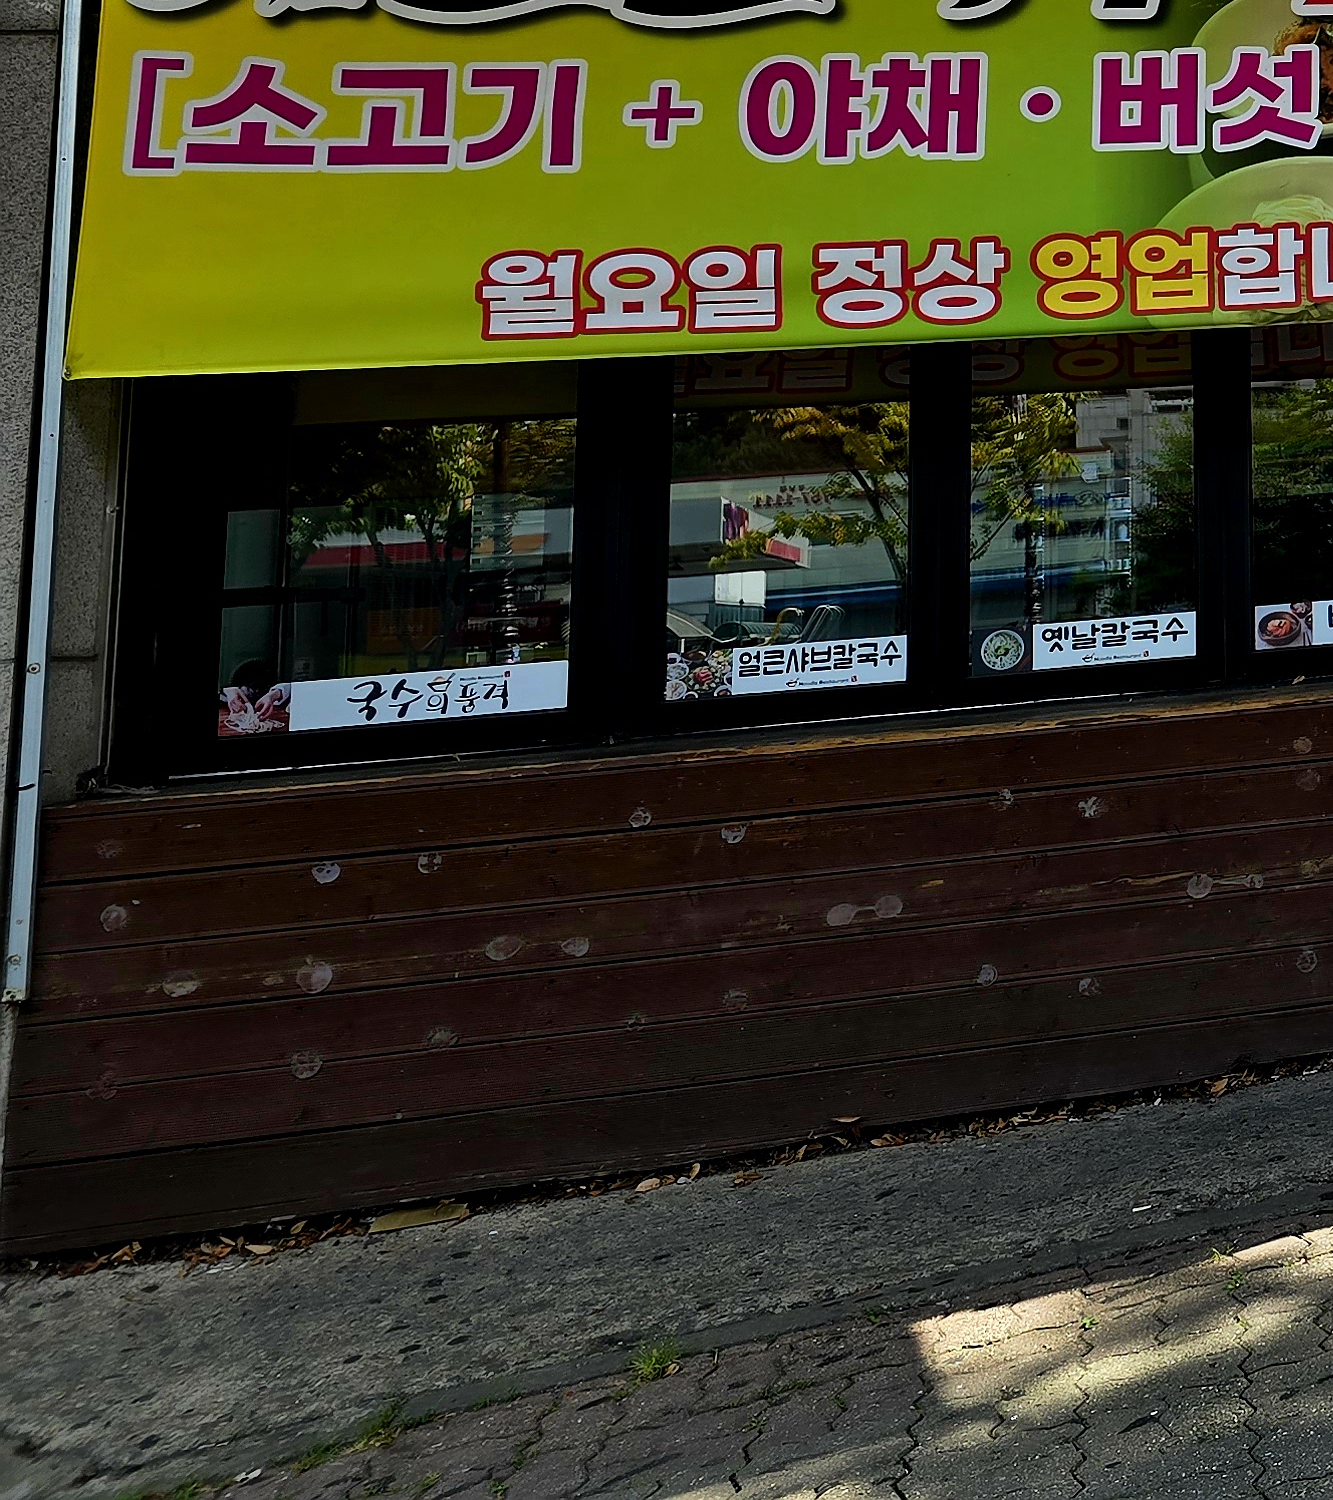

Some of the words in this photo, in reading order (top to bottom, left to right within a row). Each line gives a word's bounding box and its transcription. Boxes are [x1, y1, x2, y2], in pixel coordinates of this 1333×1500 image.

[739, 51, 987, 163] 야채
[1092, 44, 1322, 153] 버섯
[478, 244, 782, 341] 월요일
[812, 236, 1010, 329] 정상
[737, 638, 903, 679] 얼큰샤브칼국수
[1041, 616, 1190, 653] 옛날칼국수
